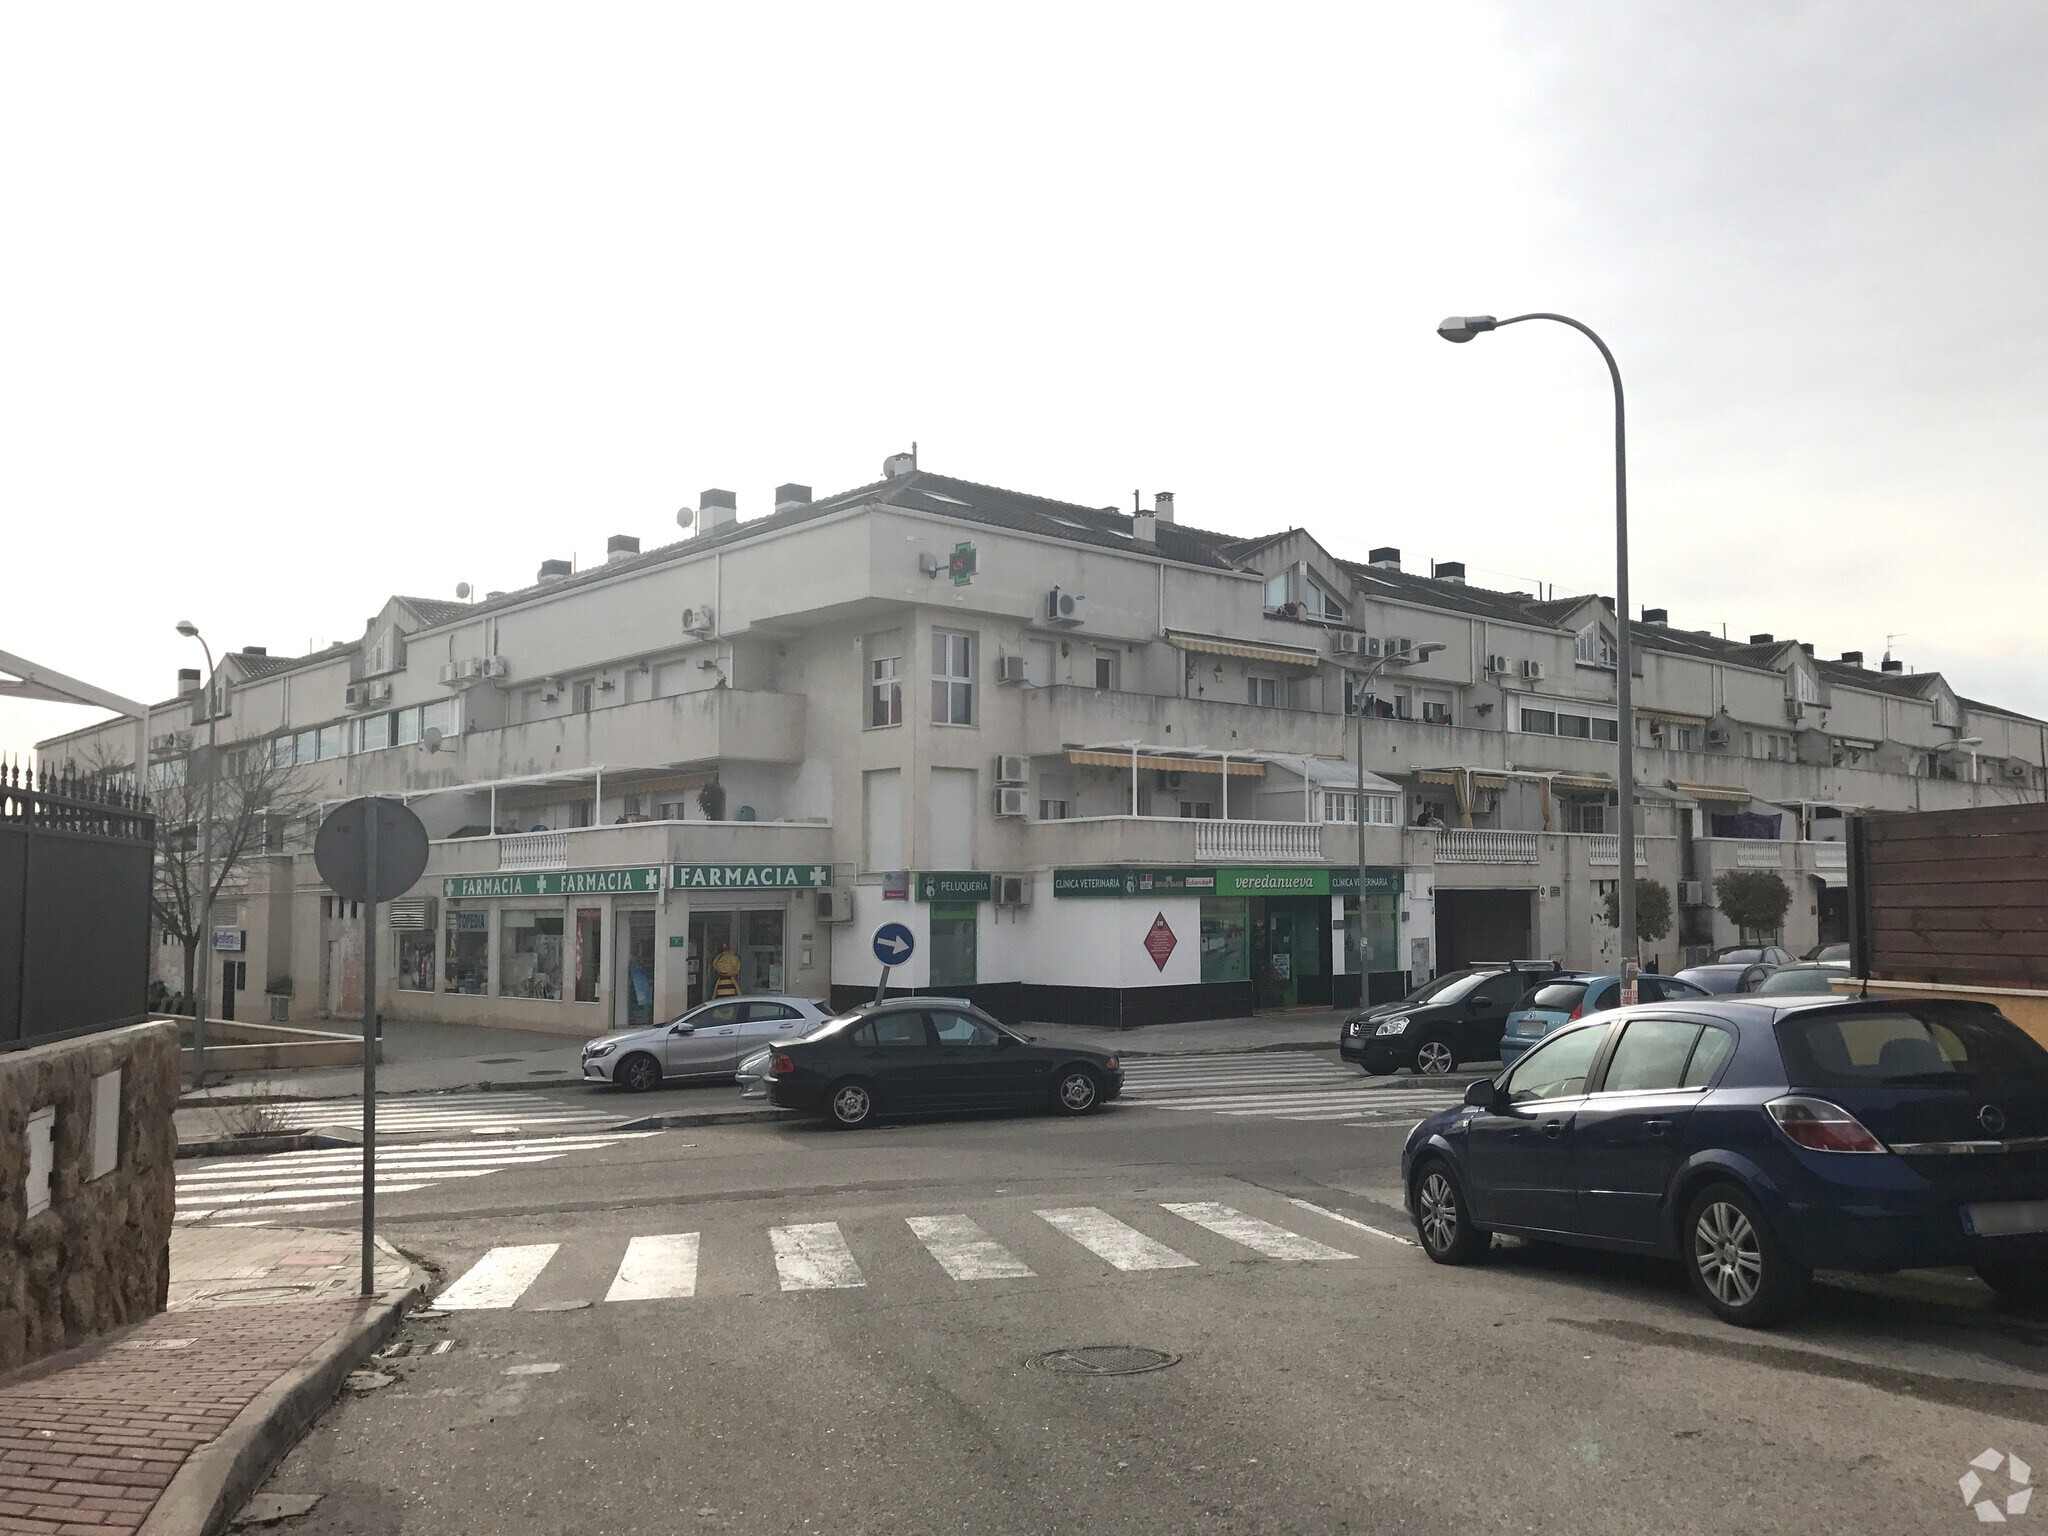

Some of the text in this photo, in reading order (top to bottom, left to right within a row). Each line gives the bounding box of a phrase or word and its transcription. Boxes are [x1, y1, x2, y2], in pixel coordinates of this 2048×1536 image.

[462, 872, 632, 895] FARMACIA FARMACIA
[680, 868, 798, 886] FARMACIA
[1055, 877, 1120, 888] CLÍNICA VETERINARIA
[1235, 874, 1314, 888] veredanueva
[1332, 876, 1388, 887] CLÍNICA VEERINARIA
[941, 880, 988, 892] PELUQUERÍA
